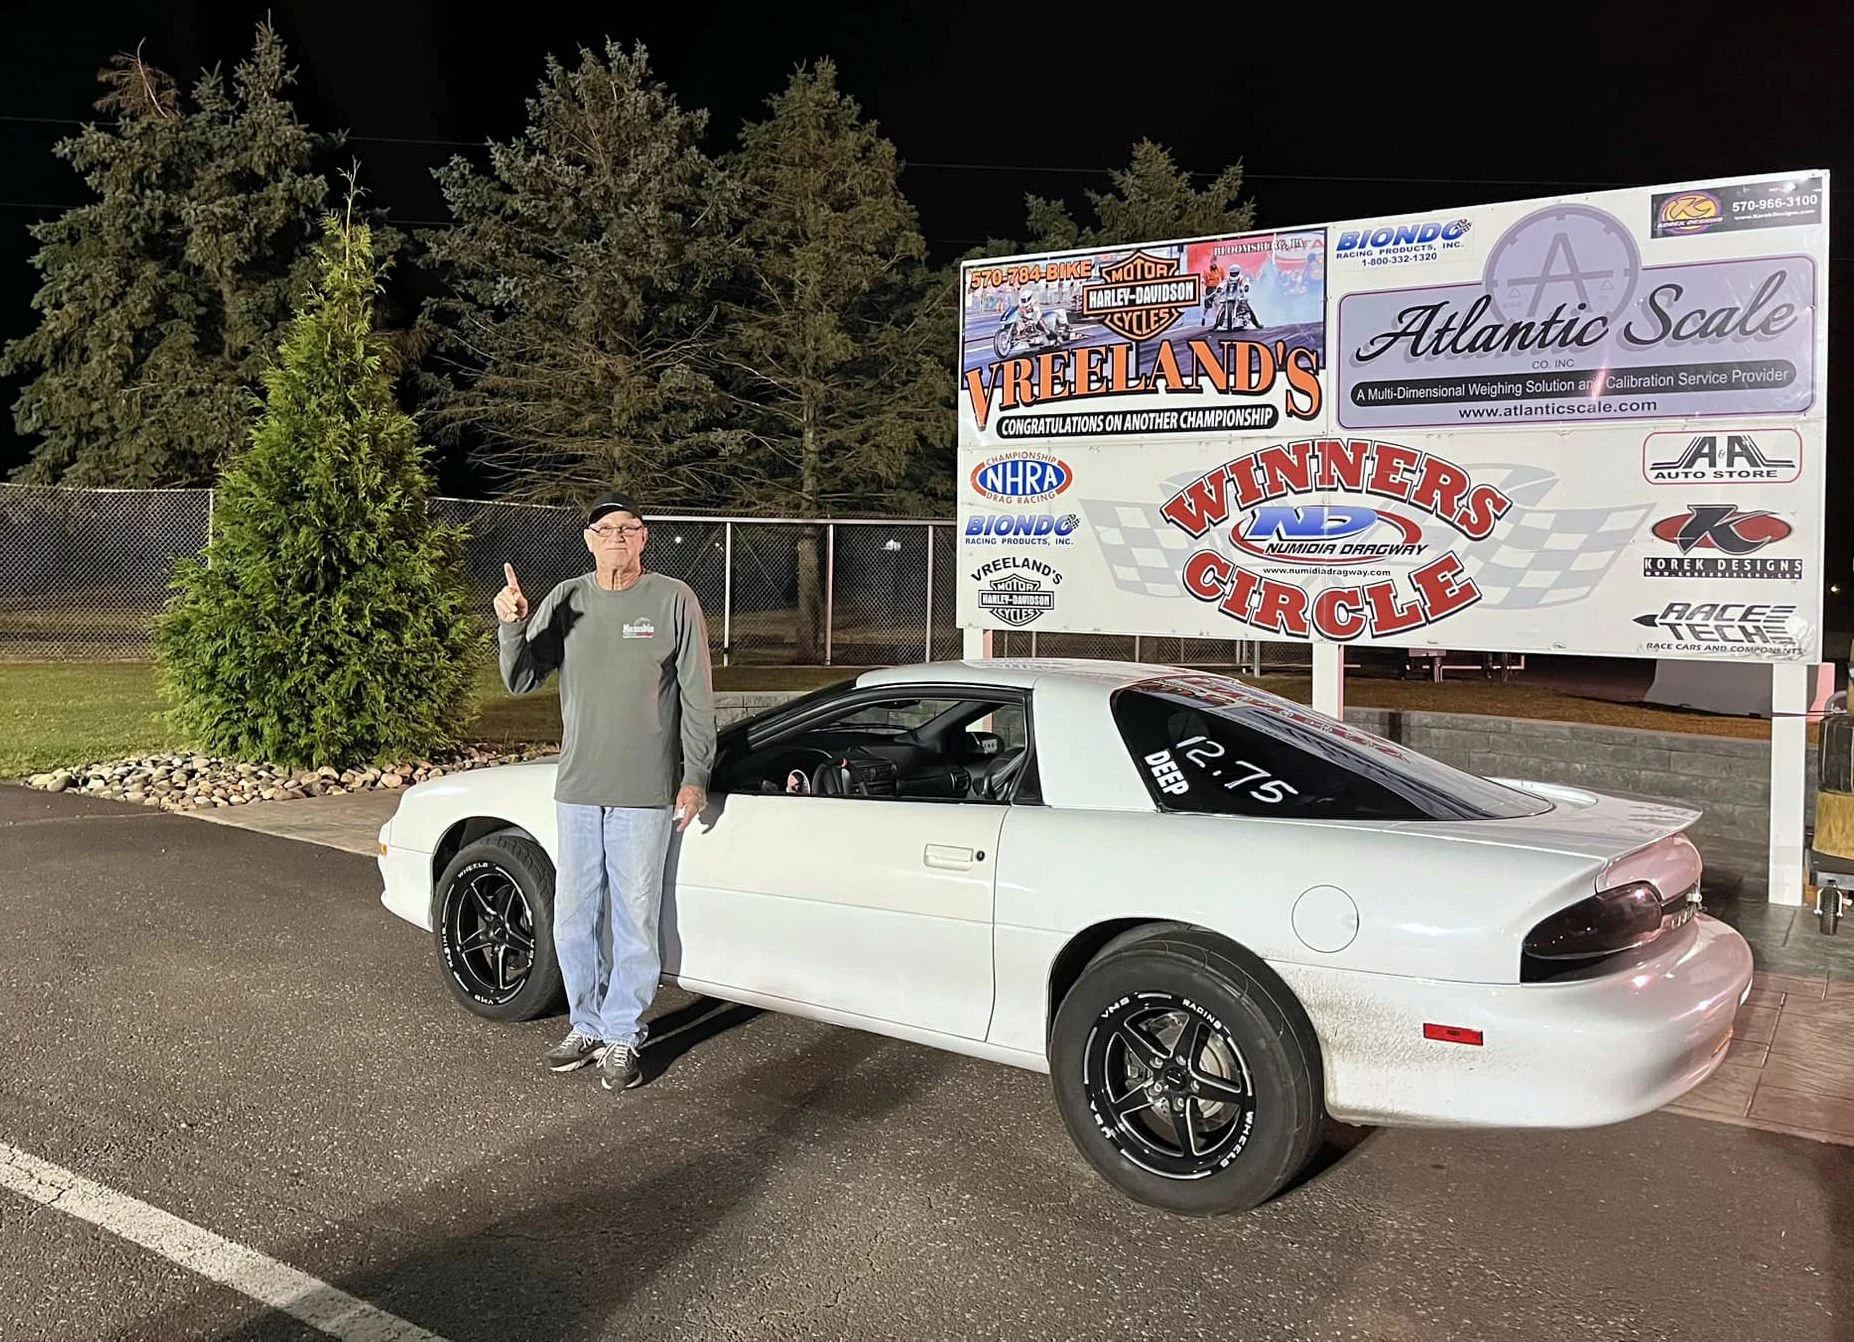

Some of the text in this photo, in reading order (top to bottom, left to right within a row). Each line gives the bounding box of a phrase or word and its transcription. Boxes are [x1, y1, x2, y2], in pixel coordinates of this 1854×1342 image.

[1731, 194, 1818, 213] 570-966-3100
[1335, 219, 1469, 251] BIONDO
[1336, 240, 1464, 259] RACING PRODUCTS, INC.
[1361, 252, 1437, 267] 1-800-332-1320
[971, 259, 1093, 290] 570-784-BIKE
[1111, 258, 1168, 283] MOTOR
[1089, 281, 1194, 309] HARLEY-DAVIDSON
[1113, 309, 1170, 335] CYCLES
[1355, 269, 1798, 362] Atlantic Scale
[1554, 358, 1575, 369] INC
[963, 338, 1324, 431] VREELAND'S
[1356, 368, 1789, 401] A Multi-Dimensional Weighing Solution an Calibration Service Provider
[1458, 399, 1657, 419] www.atlanticscale.com
[1002, 407, 1273, 436] CONGRATULATIONS ON ANOTHER CHAMPIONSHIP
[986, 451, 1057, 466] CHAMPIONSHIP
[986, 460, 1059, 495] NHRA
[1654, 469, 1778, 480] AUTO STORE
[986, 490, 1056, 504] DRAG RACING
[1159, 438, 1514, 542] WINNERS
[965, 514, 1077, 536] BIONDO
[965, 537, 1074, 546] RACING PRODUCTS, INC.
[1265, 543, 1429, 556] NUMIDIA DRAGWAY
[970, 556, 1063, 585] VREELAND'S
[1263, 566, 1391, 578] www.numidiadragway.com
[1644, 558, 1802, 571] KOREK DESIGNS
[996, 581, 1035, 591] MOTOR
[1183, 548, 1481, 642] CIRCLE
[982, 594, 1050, 606] HARLEY-DAVIDSON
[997, 608, 1036, 621] CYCLES
[1659, 603, 1772, 622] RACE
[1658, 622, 1770, 643] TECH
[1646, 642, 1803, 655] RACE CARS AND COMPONENTS
[1143, 749, 1190, 796] DEEP
[1175, 735, 1299, 804] 12.75
[1181, 998, 1223, 1031] RACING
[1219, 1110, 1255, 1169] WHEELS
